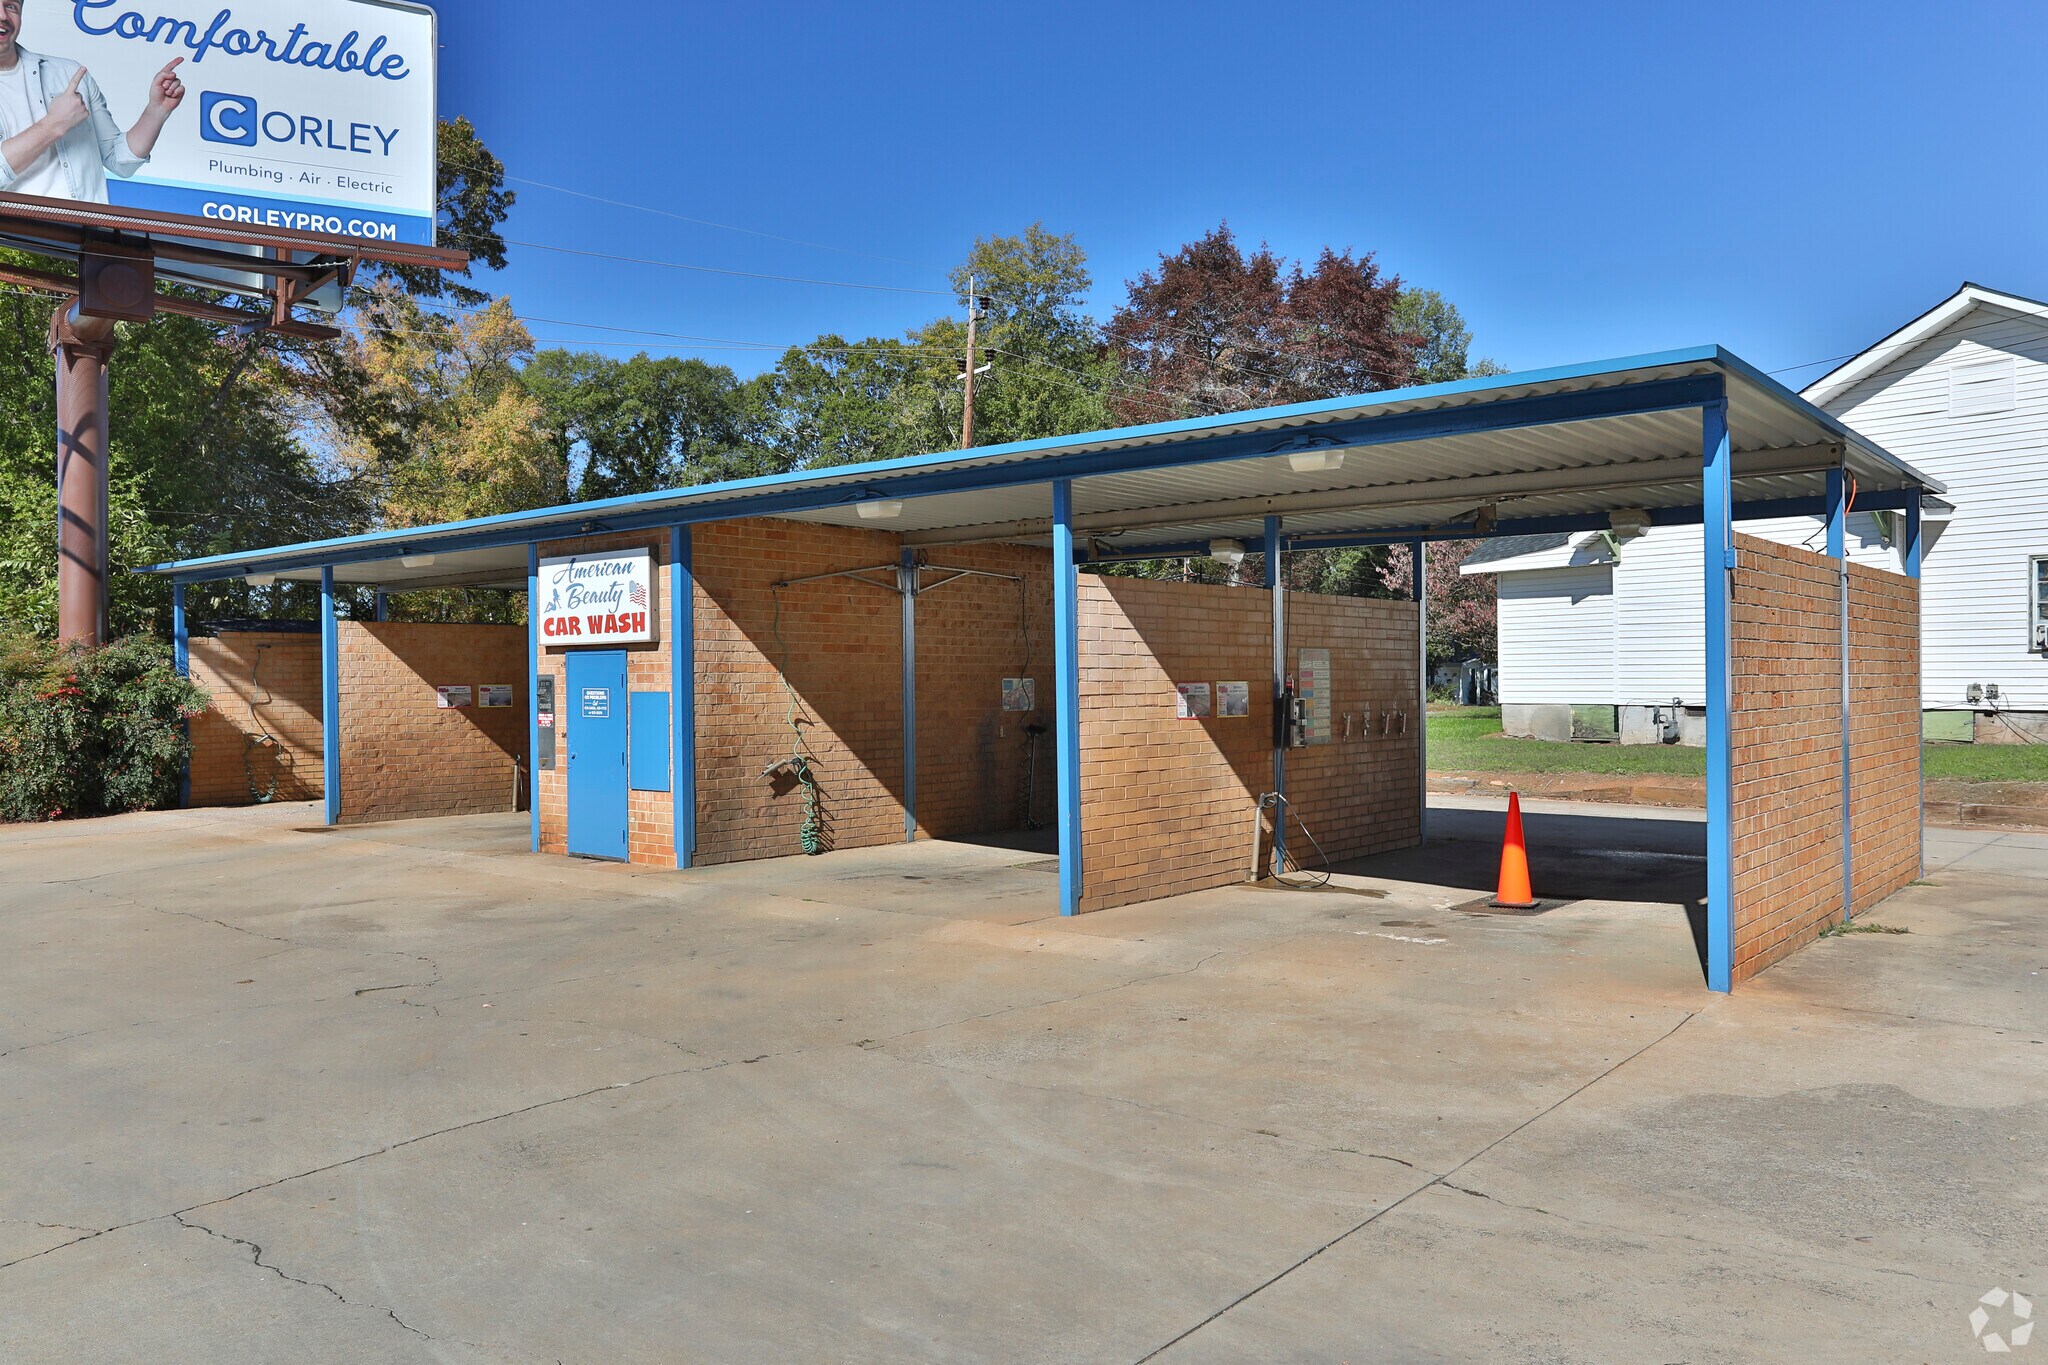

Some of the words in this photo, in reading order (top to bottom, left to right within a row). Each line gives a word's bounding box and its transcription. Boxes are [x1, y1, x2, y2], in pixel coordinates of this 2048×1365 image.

[70, 0, 410, 80] Comfortable
[208, 98, 400, 156] CORLEY
[208, 159, 283, 183] Plumbing
[299, 171, 321, 185] Air
[337, 176, 393, 194] Electric
[202, 202, 397, 241] CORLEYPRO.COM
[552, 557, 636, 585] American
[565, 580, 625, 614] Beauty
[543, 616, 582, 637] CAR
[586, 611, 646, 635] WASH
